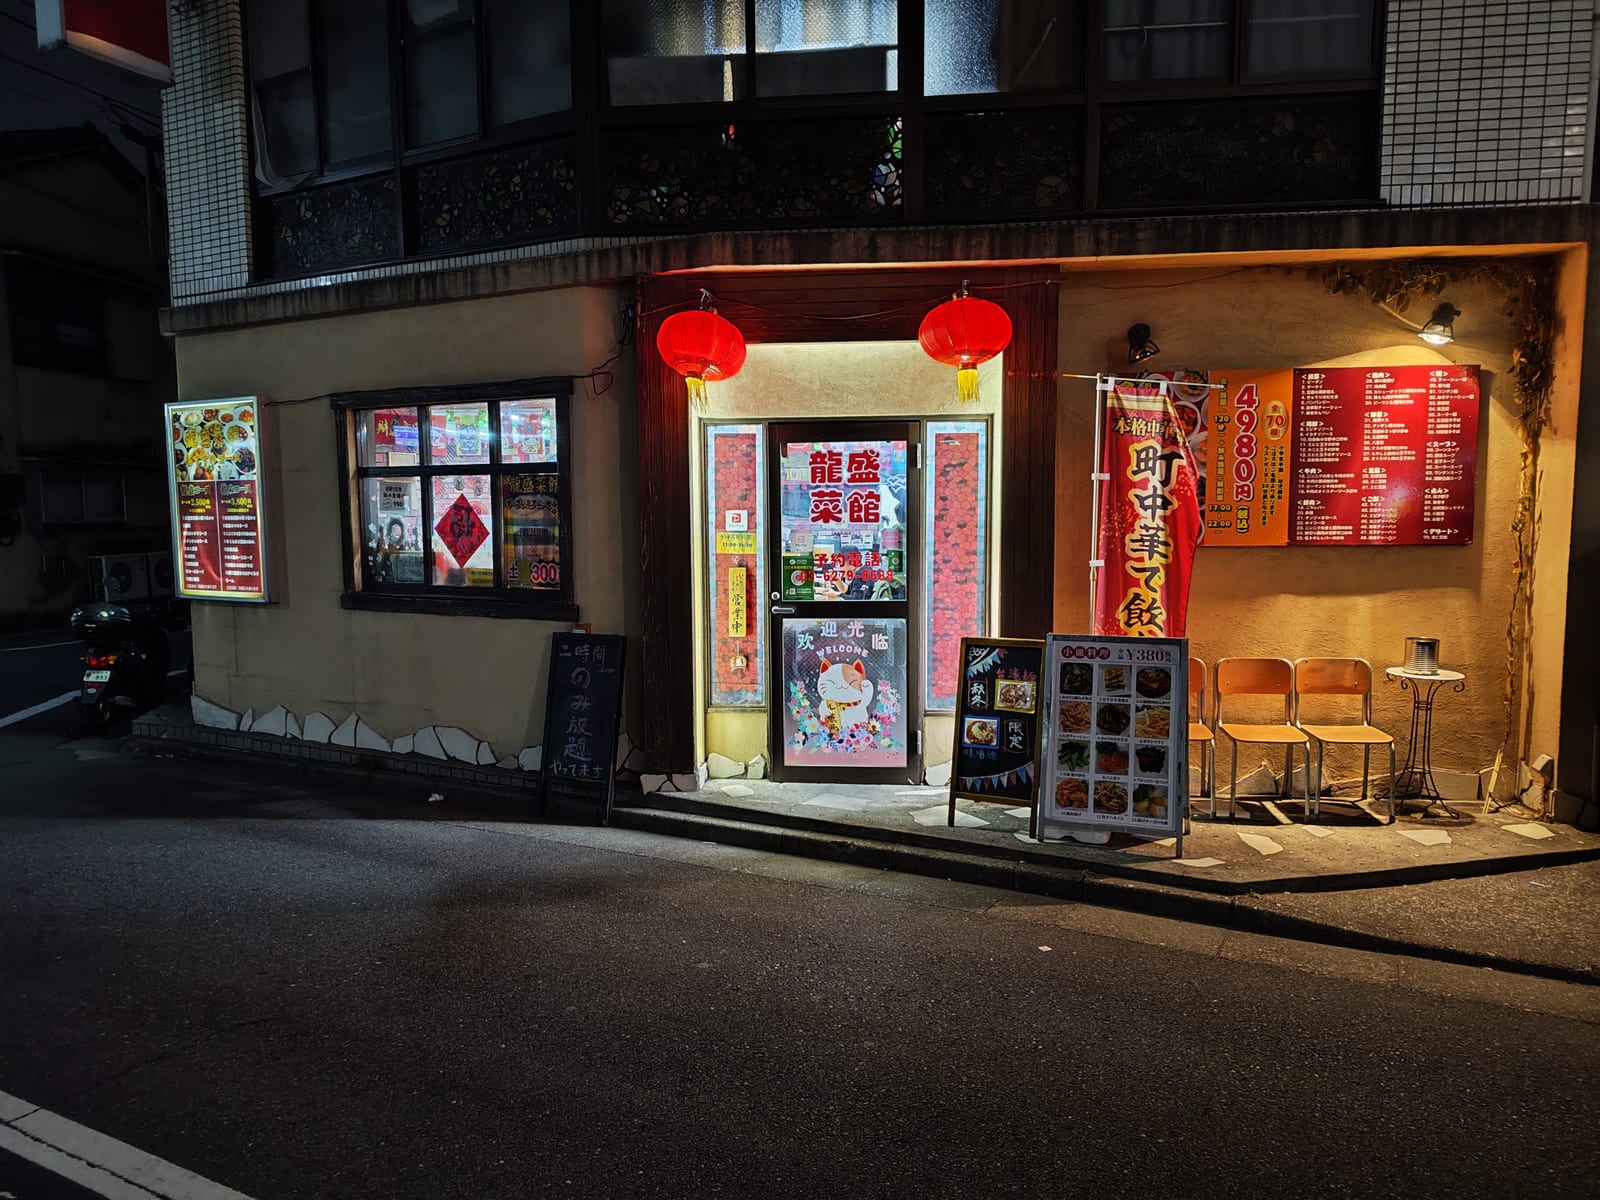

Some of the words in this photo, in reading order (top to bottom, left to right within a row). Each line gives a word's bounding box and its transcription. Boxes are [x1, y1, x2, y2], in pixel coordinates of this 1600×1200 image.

[807, 450, 880, 484] 龍盛
[809, 489, 881, 524] 菜館
[1120, 444, 1185, 637] 町中華で飲
[530, 562, 560, 583] 300
[813, 551, 881, 569] 予約電話
[797, 620, 888, 651] 欢迎光临
[816, 644, 870, 659] WELCOME
[1061, 645, 1111, 660] 小皿料理
[970, 682, 986, 708] 秋冬
[563, 666, 593, 761] のみ放題
[1008, 721, 1025, 750] 限定
[548, 758, 604, 780] やってます
